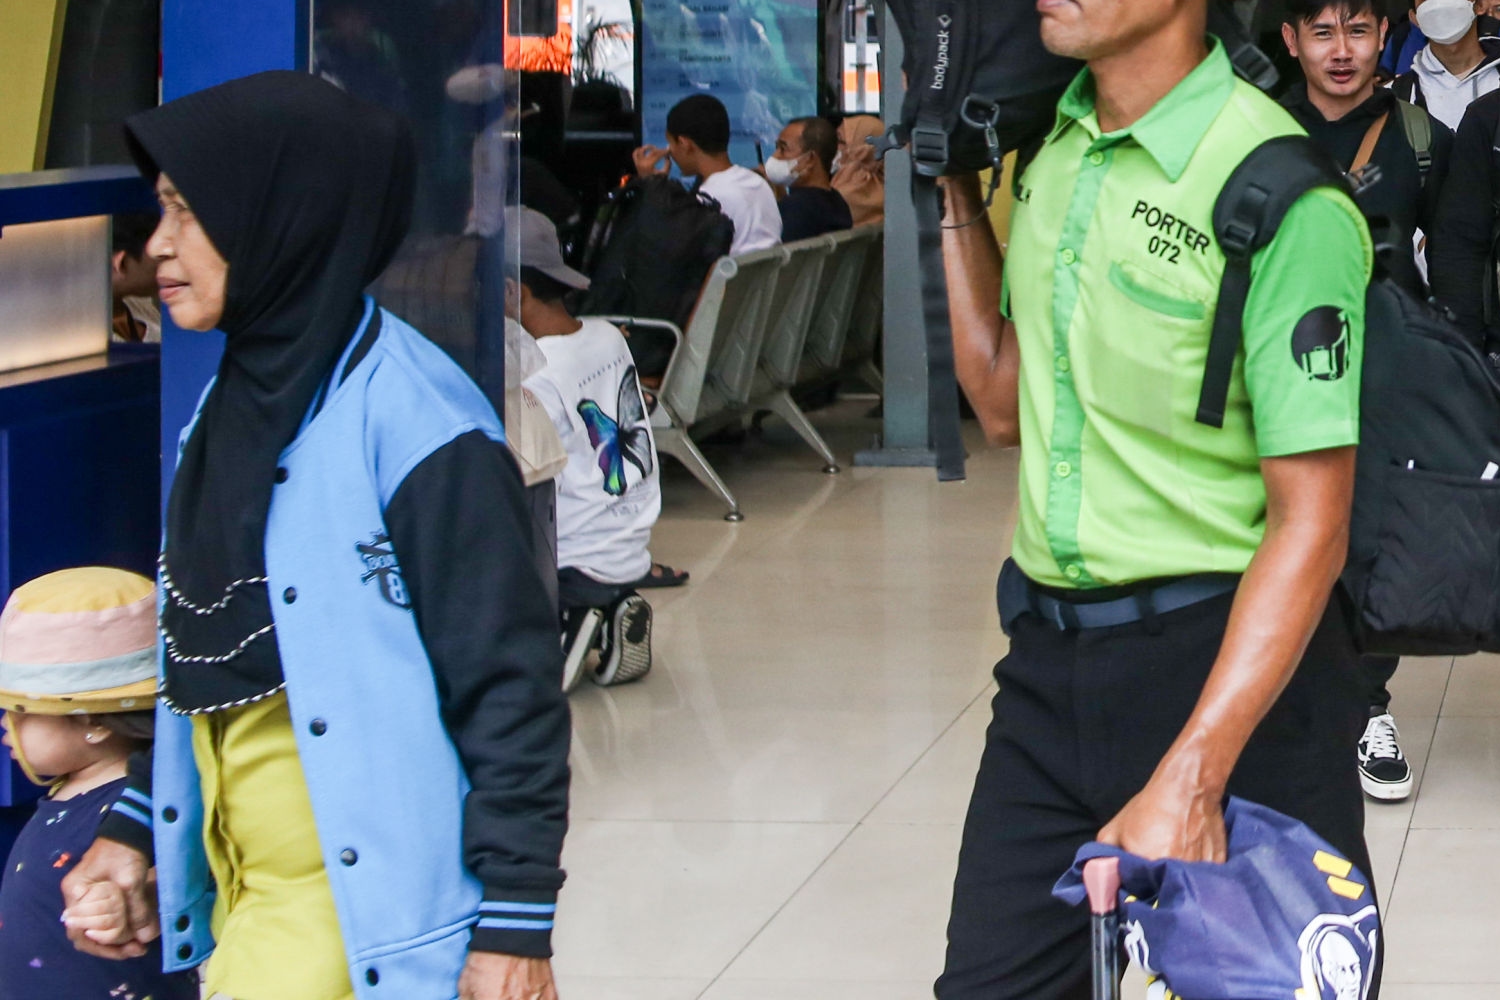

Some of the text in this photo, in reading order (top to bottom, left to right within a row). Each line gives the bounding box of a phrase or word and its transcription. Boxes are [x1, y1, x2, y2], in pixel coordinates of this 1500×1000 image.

[930, 29, 950, 90] bodypack
[1131, 200, 1210, 256] PORTER
[1148, 235, 1181, 264] 072
